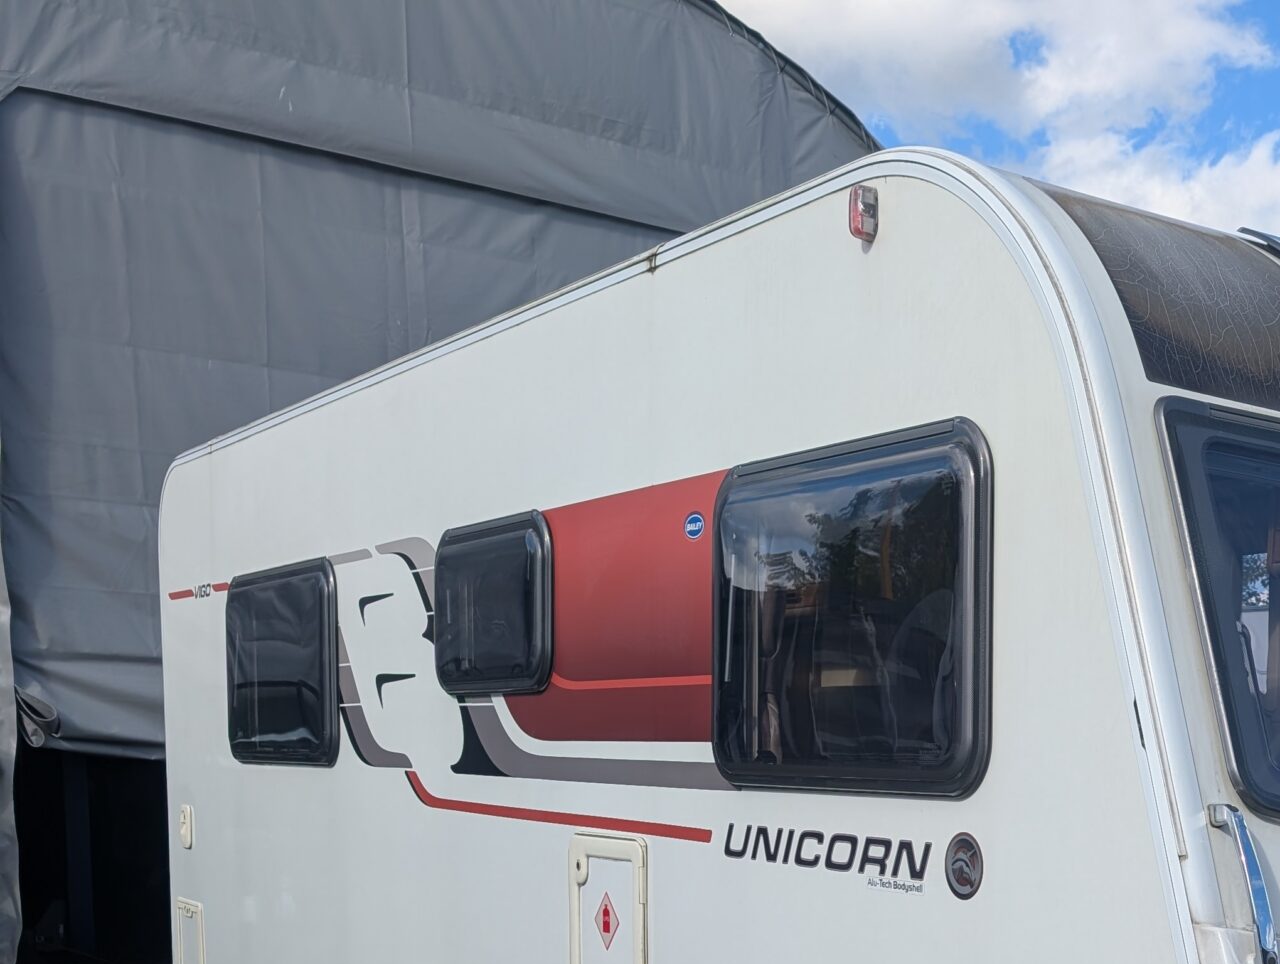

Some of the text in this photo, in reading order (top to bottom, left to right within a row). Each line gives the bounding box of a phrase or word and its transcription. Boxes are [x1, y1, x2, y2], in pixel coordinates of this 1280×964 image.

[194, 583, 211, 599] VIGO
[724, 822, 932, 881] UNICORN
[867, 877, 923, 893] Alu-Tech Bodyshell
